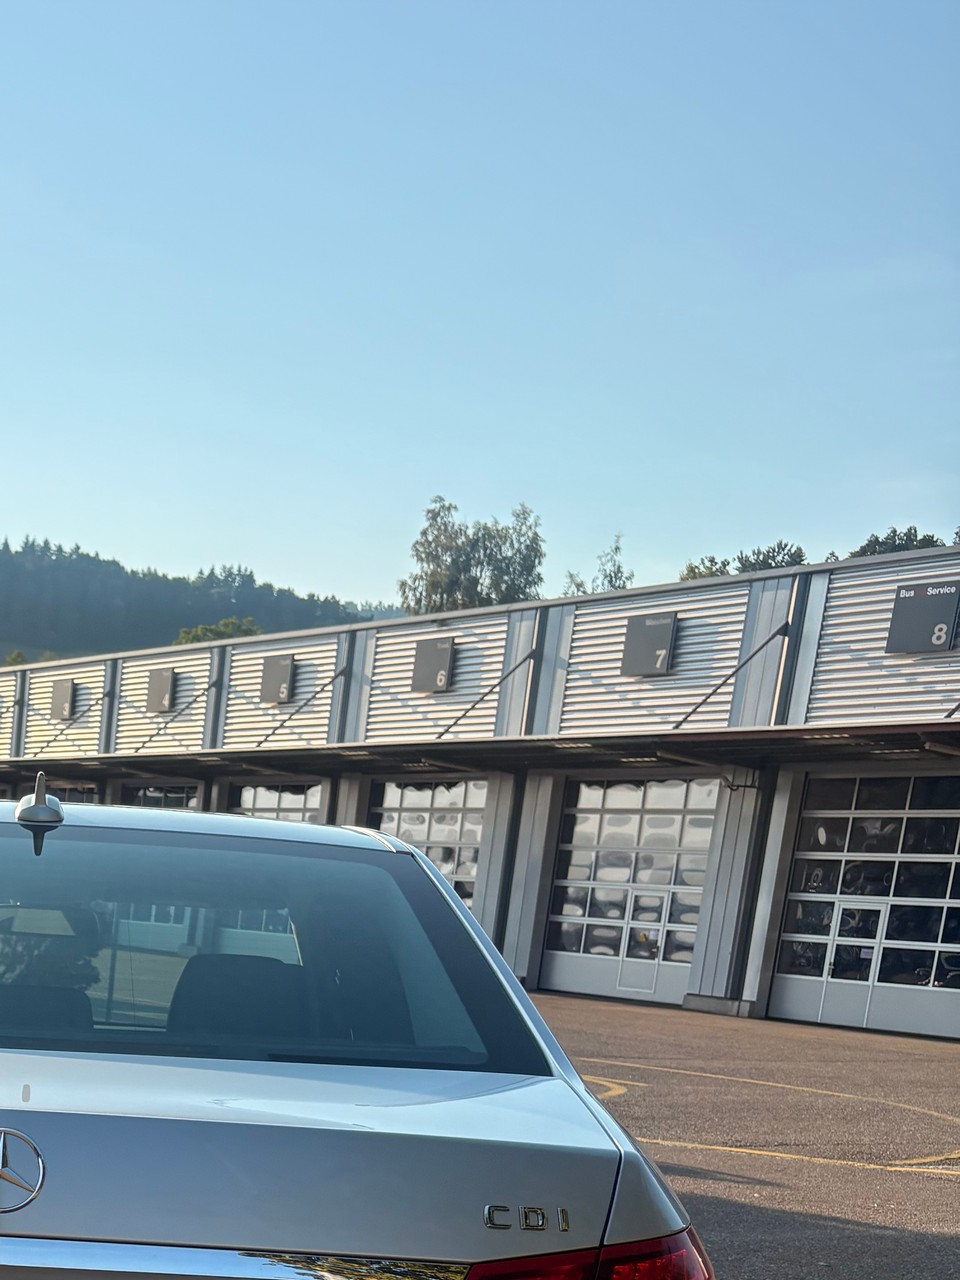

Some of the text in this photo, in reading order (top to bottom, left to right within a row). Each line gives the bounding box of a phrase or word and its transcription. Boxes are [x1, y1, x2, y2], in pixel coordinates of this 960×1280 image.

[900, 589, 915, 598] Bus
[926, 585, 956, 596] Service
[931, 623, 948, 645] 8
[655, 649, 666, 668] 7
[436, 670, 446, 687] 6
[279, 683, 287, 698] 5
[161, 693, 169, 707] 4
[483, 1204, 570, 1232] CDI
